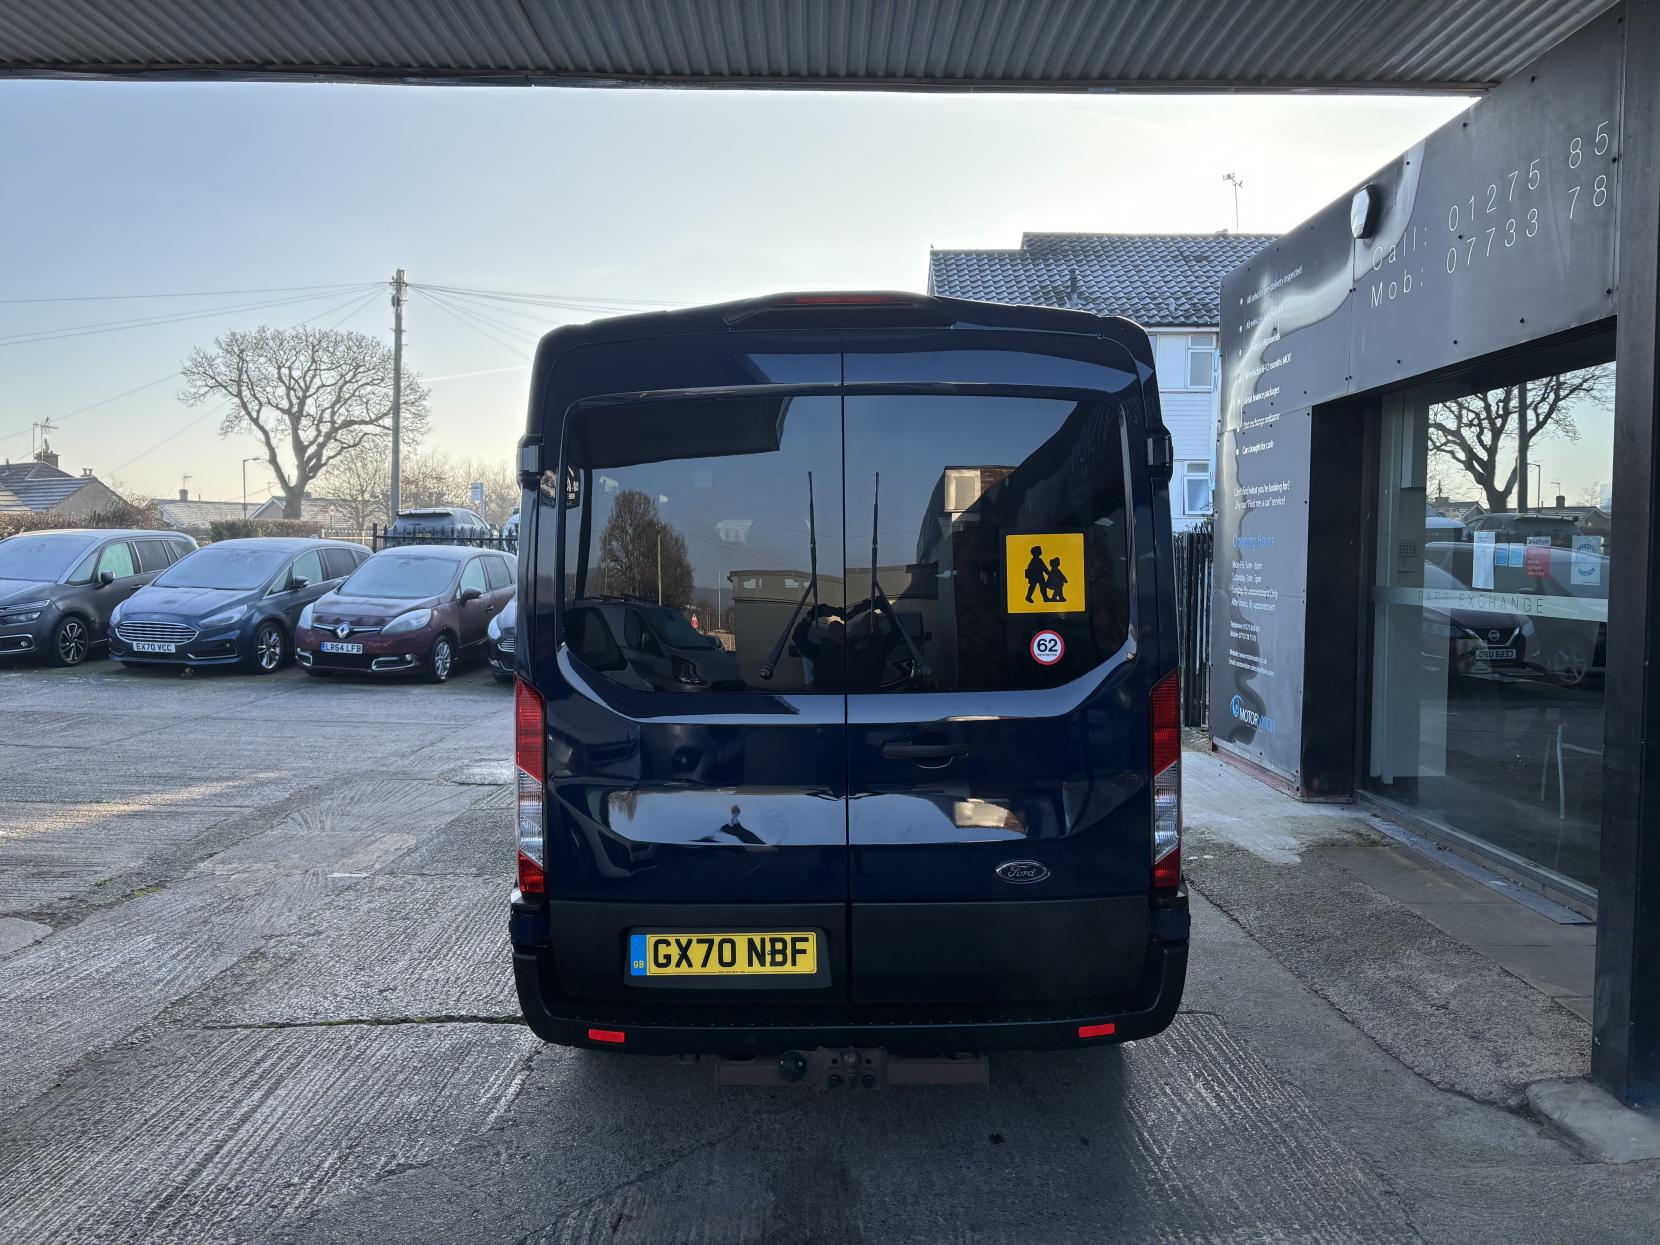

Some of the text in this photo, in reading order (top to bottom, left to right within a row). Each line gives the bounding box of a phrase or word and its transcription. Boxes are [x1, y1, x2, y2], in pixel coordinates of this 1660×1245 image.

[1372, 121, 1609, 271] Call: 01275 85
[1371, 174, 1607, 308] Mob: 07733 78
[1282, 352, 1292, 364] MOT
[1269, 481, 1282, 494] looking
[1232, 532, 1276, 551] Opening Hours
[1458, 593, 1544, 614] EXCHANGE
[136, 642, 172, 652] EX70 VCC
[325, 643, 362, 653] LR64 LFB
[1037, 638, 1058, 653] 62
[652, 936, 810, 969] GX70 NBF
[633, 960, 645, 969] GB
